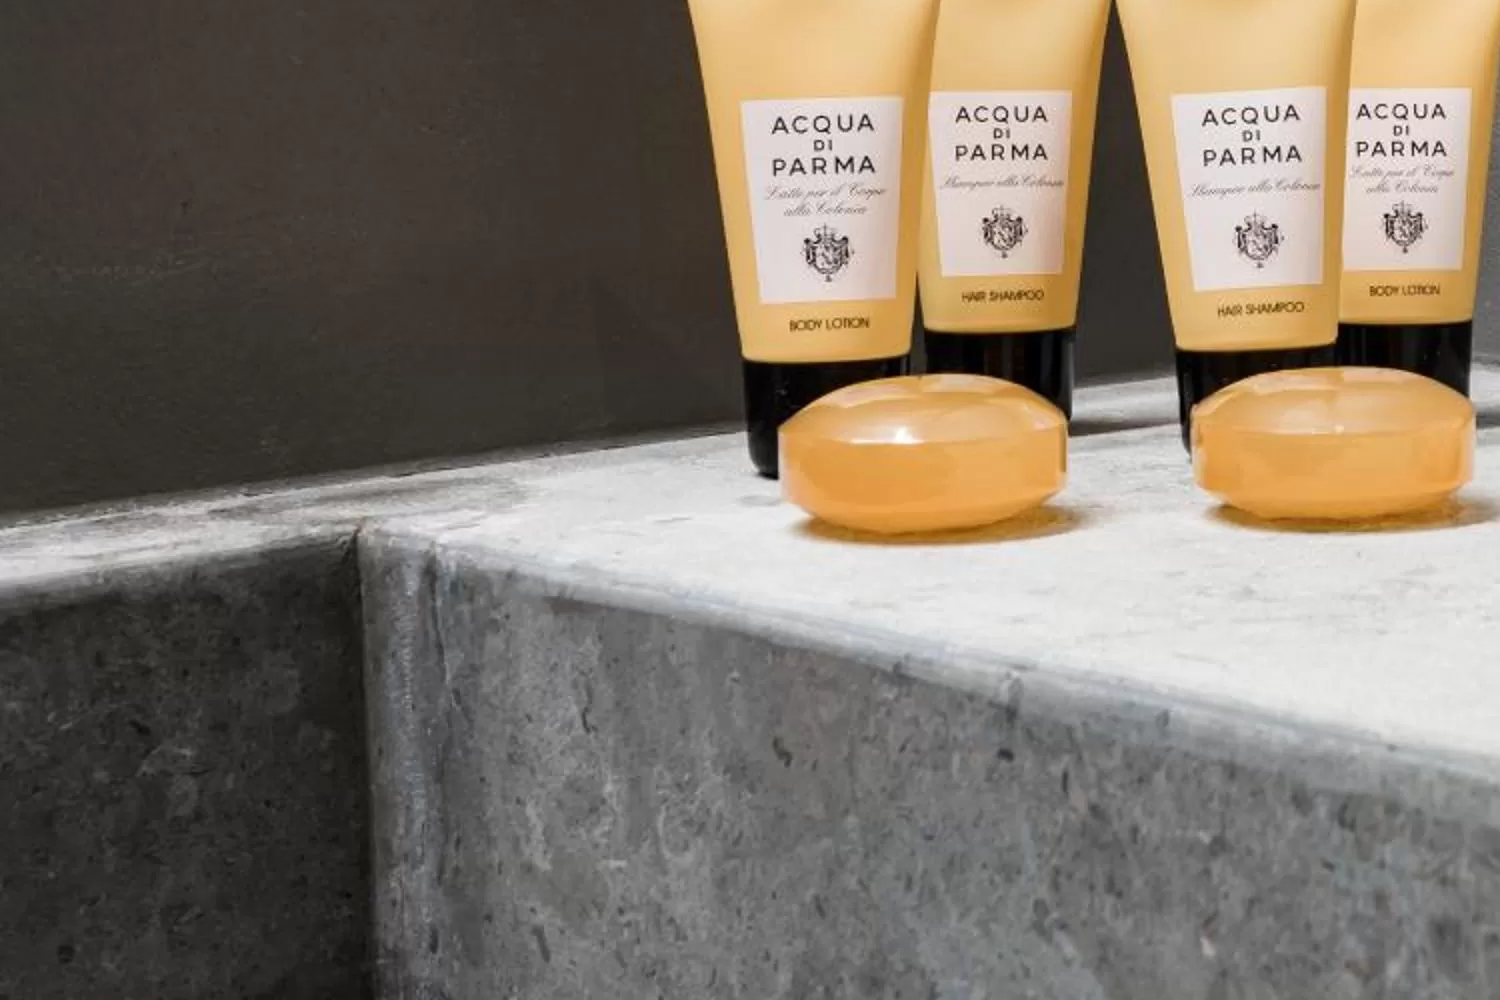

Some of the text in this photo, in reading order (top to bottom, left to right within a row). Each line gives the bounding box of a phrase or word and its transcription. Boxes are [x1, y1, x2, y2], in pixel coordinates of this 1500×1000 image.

[955, 105, 1049, 124] ACQUA
[1201, 104, 1301, 127] ACQUA
[1356, 103, 1447, 119] ACQUA
[771, 113, 875, 135] ACQUA
[1393, 125, 1410, 136] DI
[993, 127, 1011, 139] DI
[1242, 129, 1261, 142] DI
[813, 139, 833, 151] DI
[955, 143, 1049, 162] PARMA
[1356, 140, 1448, 157] PARMA
[1203, 145, 1303, 167] PARMA
[772, 155, 876, 177] PARMA
[961, 288, 1045, 304] HAIR SHAMPOO
[1369, 284, 1441, 298] BODY LOTION
[1217, 300, 1305, 318] HAIR SHAMPOO
[789, 316, 870, 333] BODY LOTION
